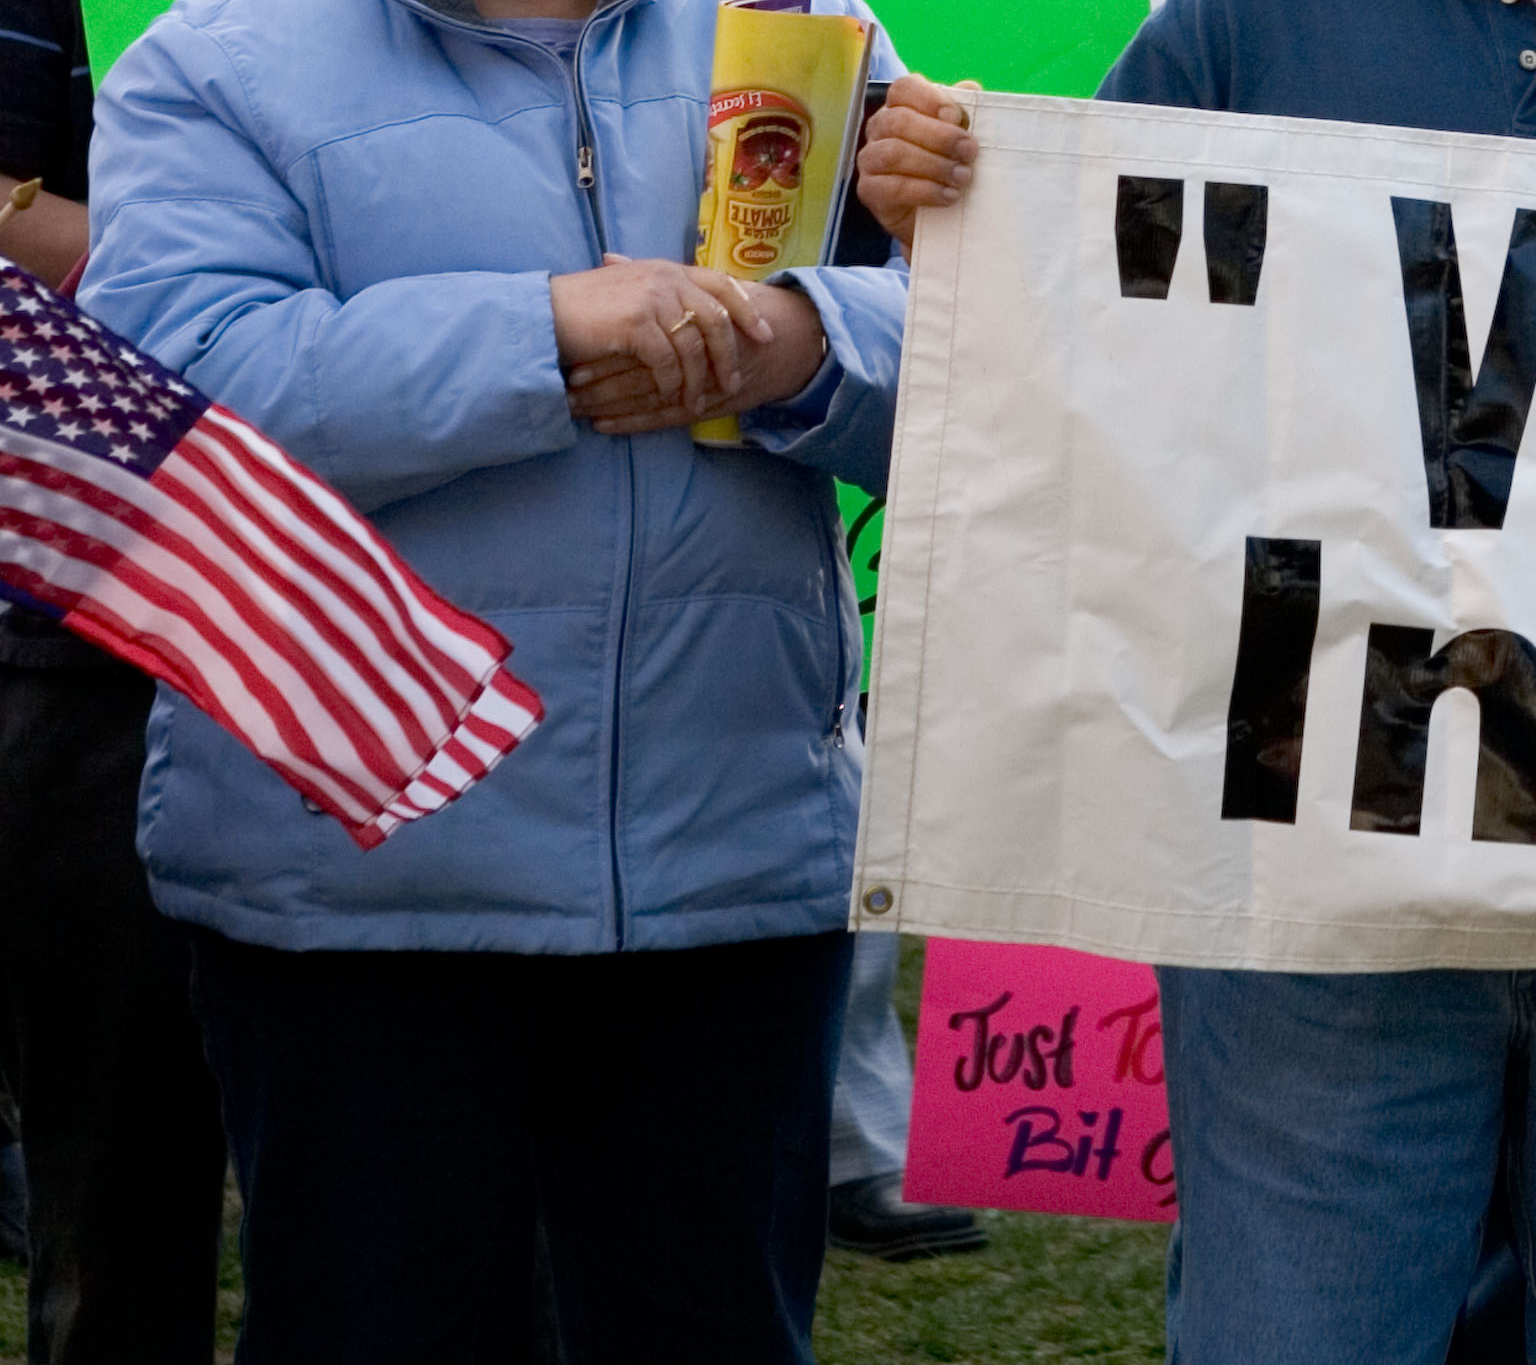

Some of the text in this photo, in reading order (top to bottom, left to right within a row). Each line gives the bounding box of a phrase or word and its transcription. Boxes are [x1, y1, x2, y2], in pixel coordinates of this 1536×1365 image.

[730, 202, 792, 229] TOMATE
[949, 992, 1078, 1092] Just
[1003, 1106, 1123, 1182] Bit
